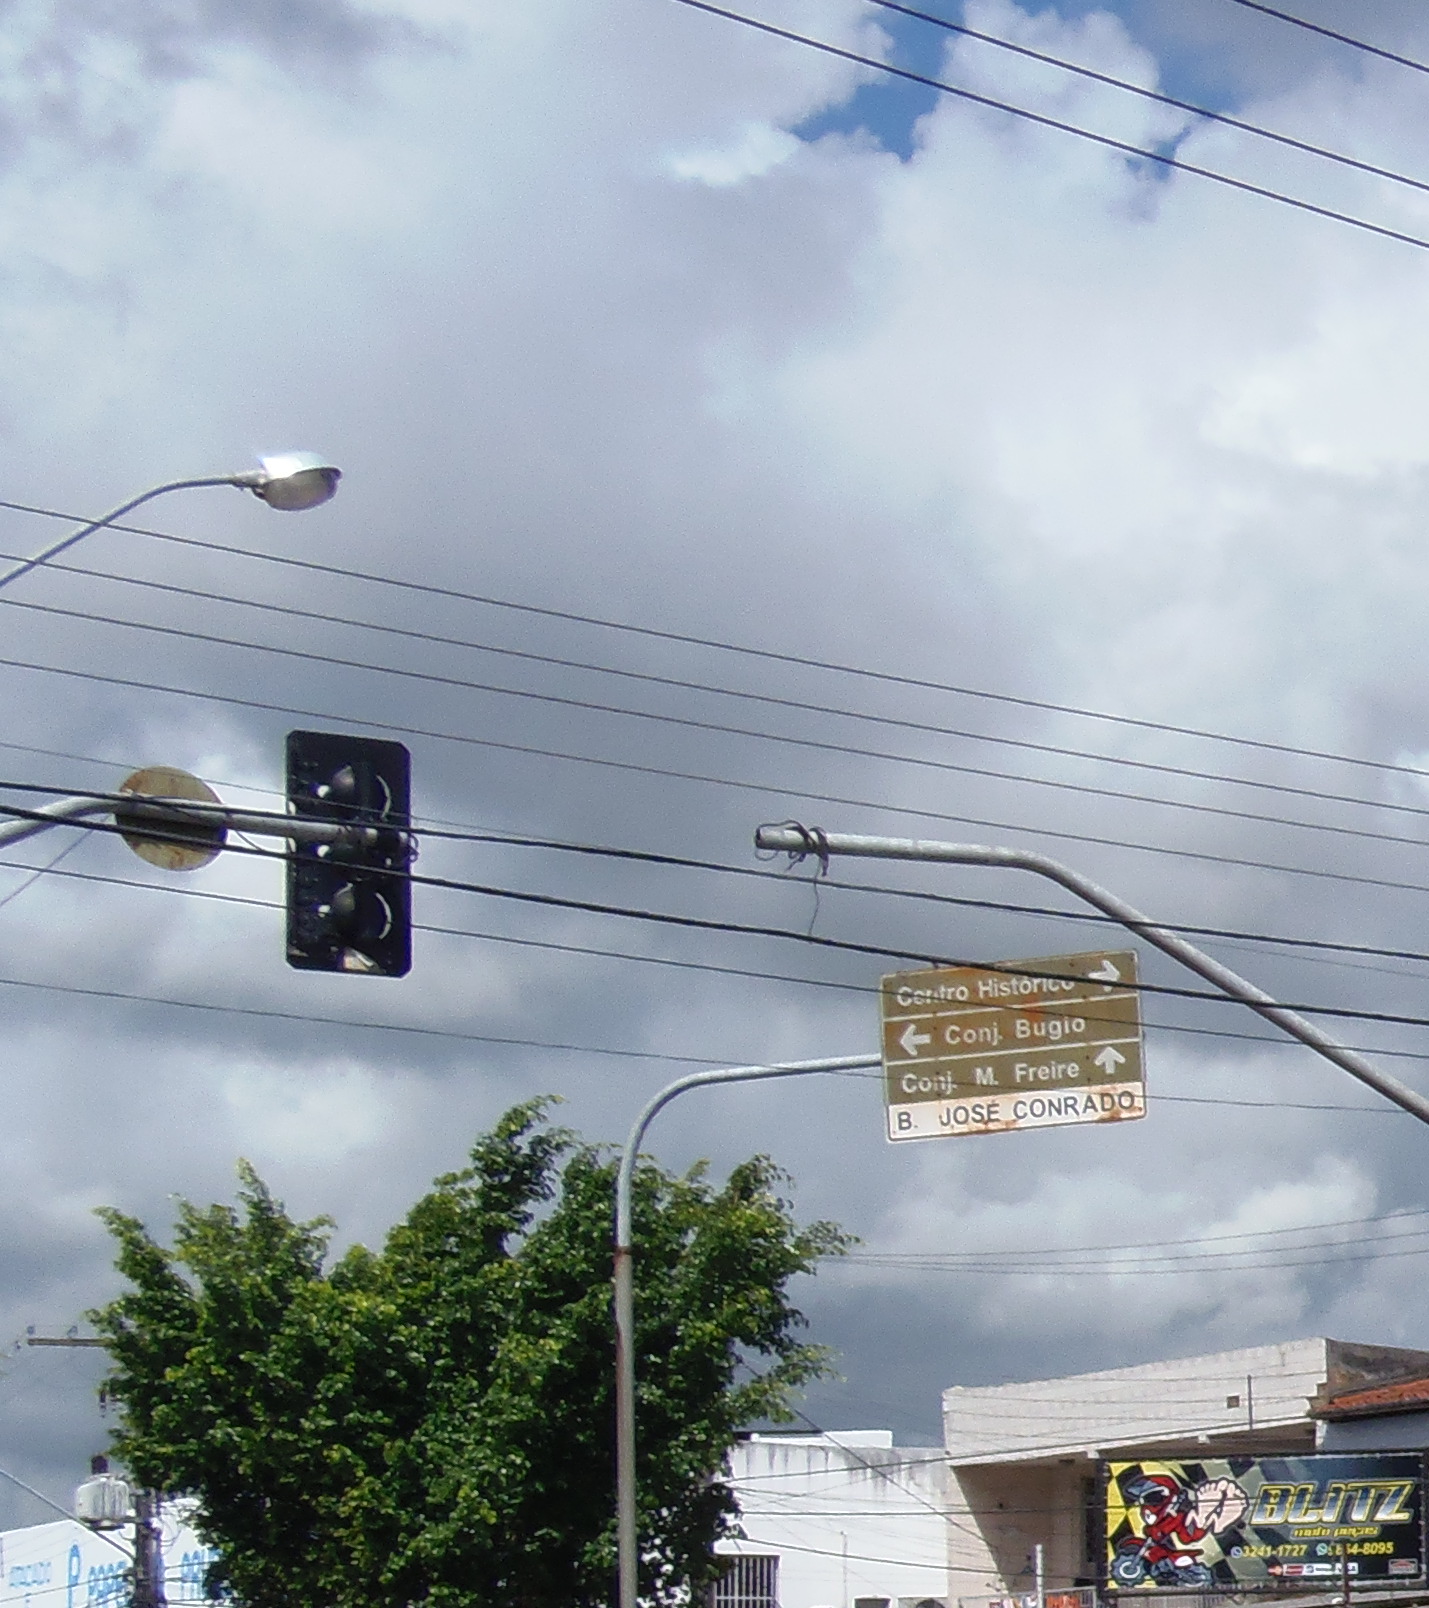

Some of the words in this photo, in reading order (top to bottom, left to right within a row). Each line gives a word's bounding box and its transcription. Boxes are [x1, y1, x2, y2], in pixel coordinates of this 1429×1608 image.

[897, 985, 969, 1007] Centro
[977, 976, 1075, 999] Histórico
[945, 1022, 1003, 1046] Conj.
[1015, 1016, 1086, 1040] Bugio
[902, 1072, 957, 1095] Conj.
[975, 1066, 999, 1086] M.
[1015, 1061, 1080, 1083] Freire
[897, 1111, 918, 1131] B.
[1013, 1090, 1135, 1120] CONRADO
[1251, 1481, 1414, 1525] BLITZ
